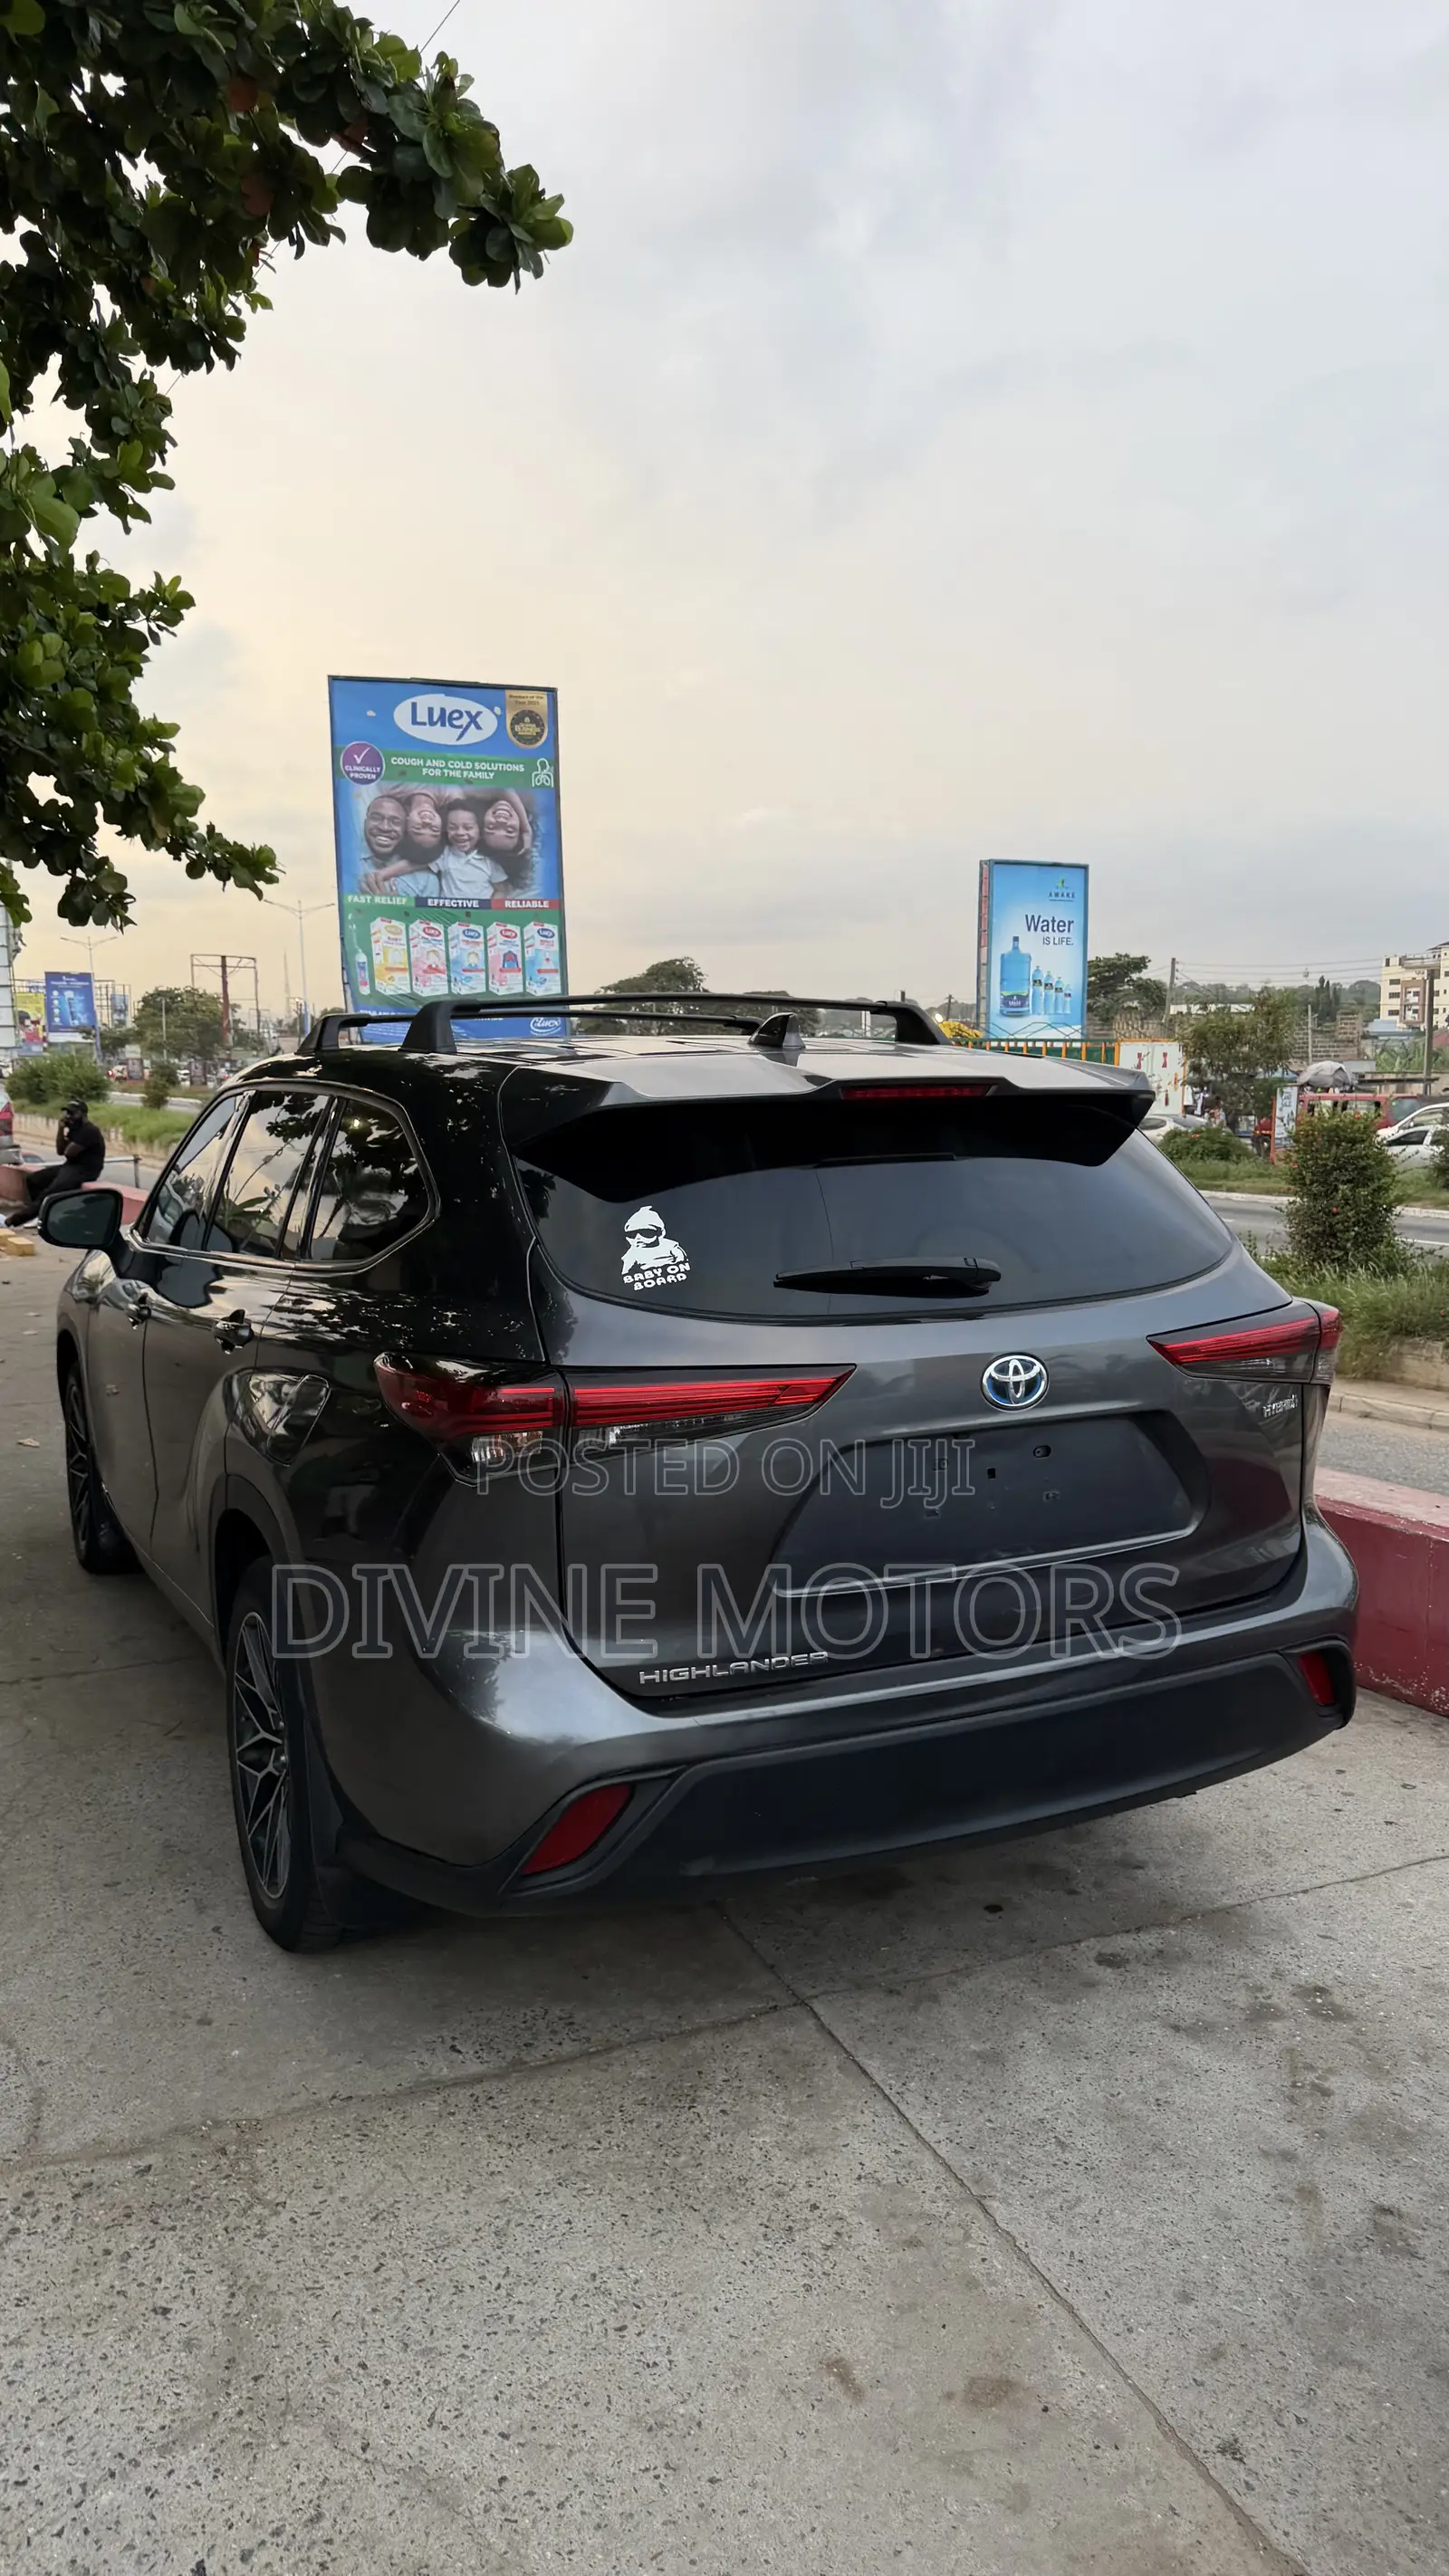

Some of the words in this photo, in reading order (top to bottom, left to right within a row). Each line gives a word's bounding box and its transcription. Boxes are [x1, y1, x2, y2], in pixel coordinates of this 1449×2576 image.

[410, 702, 484, 742] Luex
[344, 764, 381, 773] CLINICALLY
[390, 757, 424, 767] COUGH
[426, 759, 446, 768] AND
[447, 760, 473, 770] COLD
[474, 761, 525, 772] SOLUTIONS
[350, 771, 377, 780] PROVEN
[422, 768, 441, 777] FOR
[443, 769, 462, 778] THE
[463, 771, 494, 780] FAMILY
[348, 895, 371, 904] FAST
[375, 895, 408, 905] RELIEF
[1048, 891, 1075, 899] AWAKE
[427, 898, 479, 908] EFFECTIVE
[504, 900, 550, 909] RELIABLE
[1024, 914, 1075, 934] Water
[1042, 935, 1051, 946] IS
[1052, 935, 1074, 946] LIFE.
[623, 1268, 663, 1284] BABY
[667, 1262, 691, 1274] ON
[633, 1272, 687, 1291] BOARD
[639, 1652, 829, 1685] HIGHLANDER
